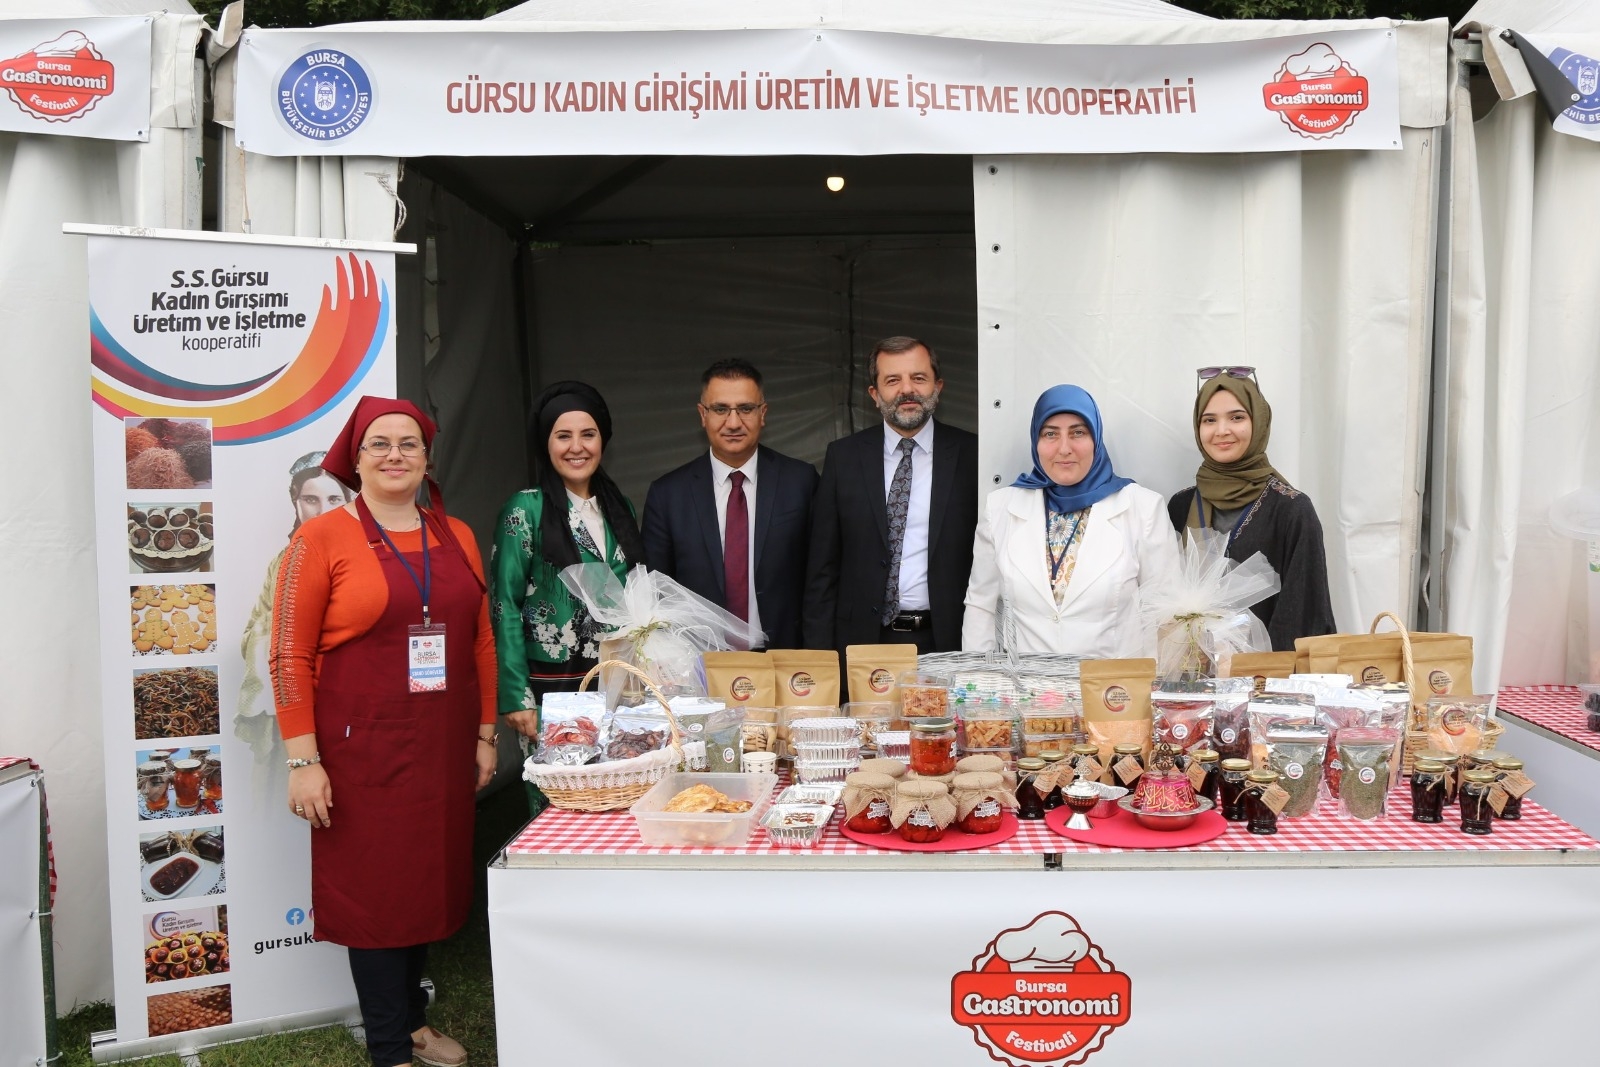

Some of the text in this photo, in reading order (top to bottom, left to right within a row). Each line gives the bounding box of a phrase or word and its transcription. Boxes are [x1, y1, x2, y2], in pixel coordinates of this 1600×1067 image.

[37, 60, 72, 71] Bursa
[306, 52, 345, 67] BURSA
[2, 68, 107, 90] Gastronomi
[1300, 83, 1333, 91] Bursa
[29, 93, 79, 110] Festivali
[446, 69, 1197, 119] GÜRSU KADIN GİRİŞİMİ ÜRETİM VE İŞLETME KOOPERATİFİ
[1270, 91, 1363, 105] Gastronomi
[281, 90, 369, 138] BÜYÜKŞEHİR BELEDİYESİ
[1298, 113, 1339, 128] Festivali
[152, 291, 210, 311] Kadın
[206, 315, 231, 331] ve
[182, 333, 261, 352] kooperatifi
[254, 932, 320, 954] gursuk
[1015, 978, 1067, 993] Bursa
[963, 993, 1119, 1015] Gastronomi
[1005, 1030, 1078, 1053] Festivali
